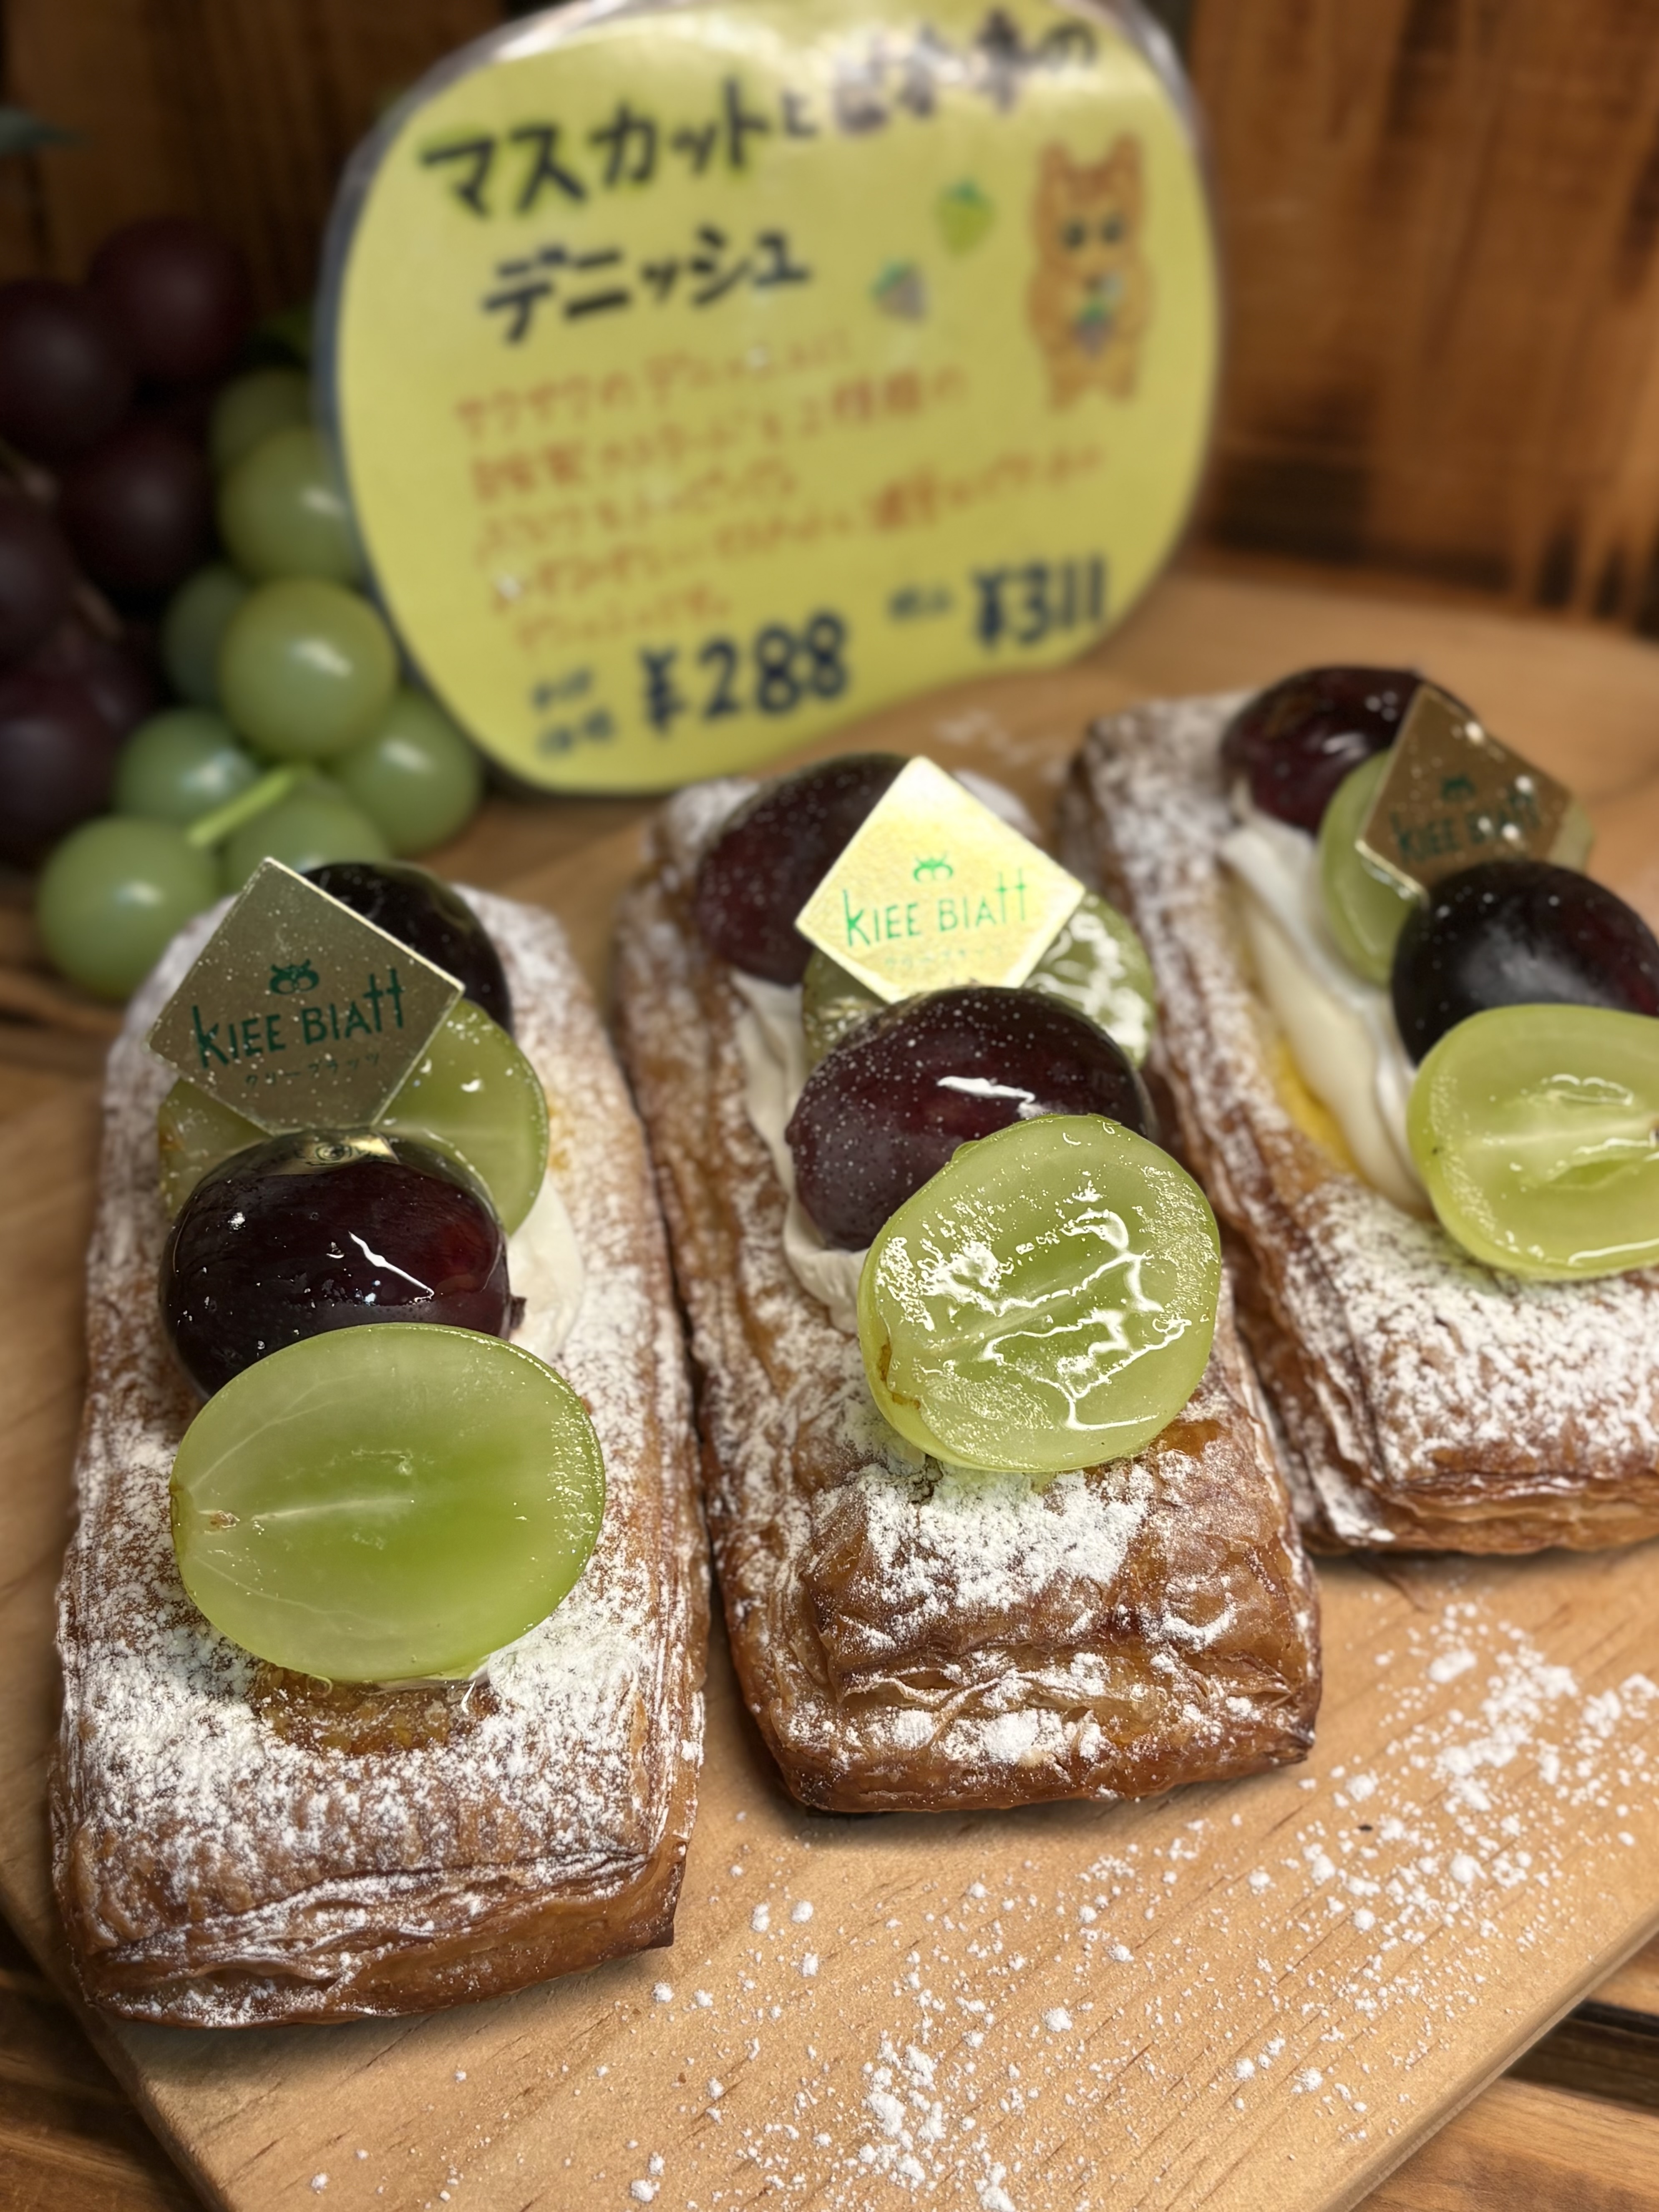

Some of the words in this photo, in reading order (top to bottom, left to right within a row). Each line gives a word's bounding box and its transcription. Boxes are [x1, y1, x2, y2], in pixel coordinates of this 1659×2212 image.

[483, 224, 811, 345] デニッシュ
[970, 556, 1108, 652] ¥311
[640, 608, 849, 735] ¥288
